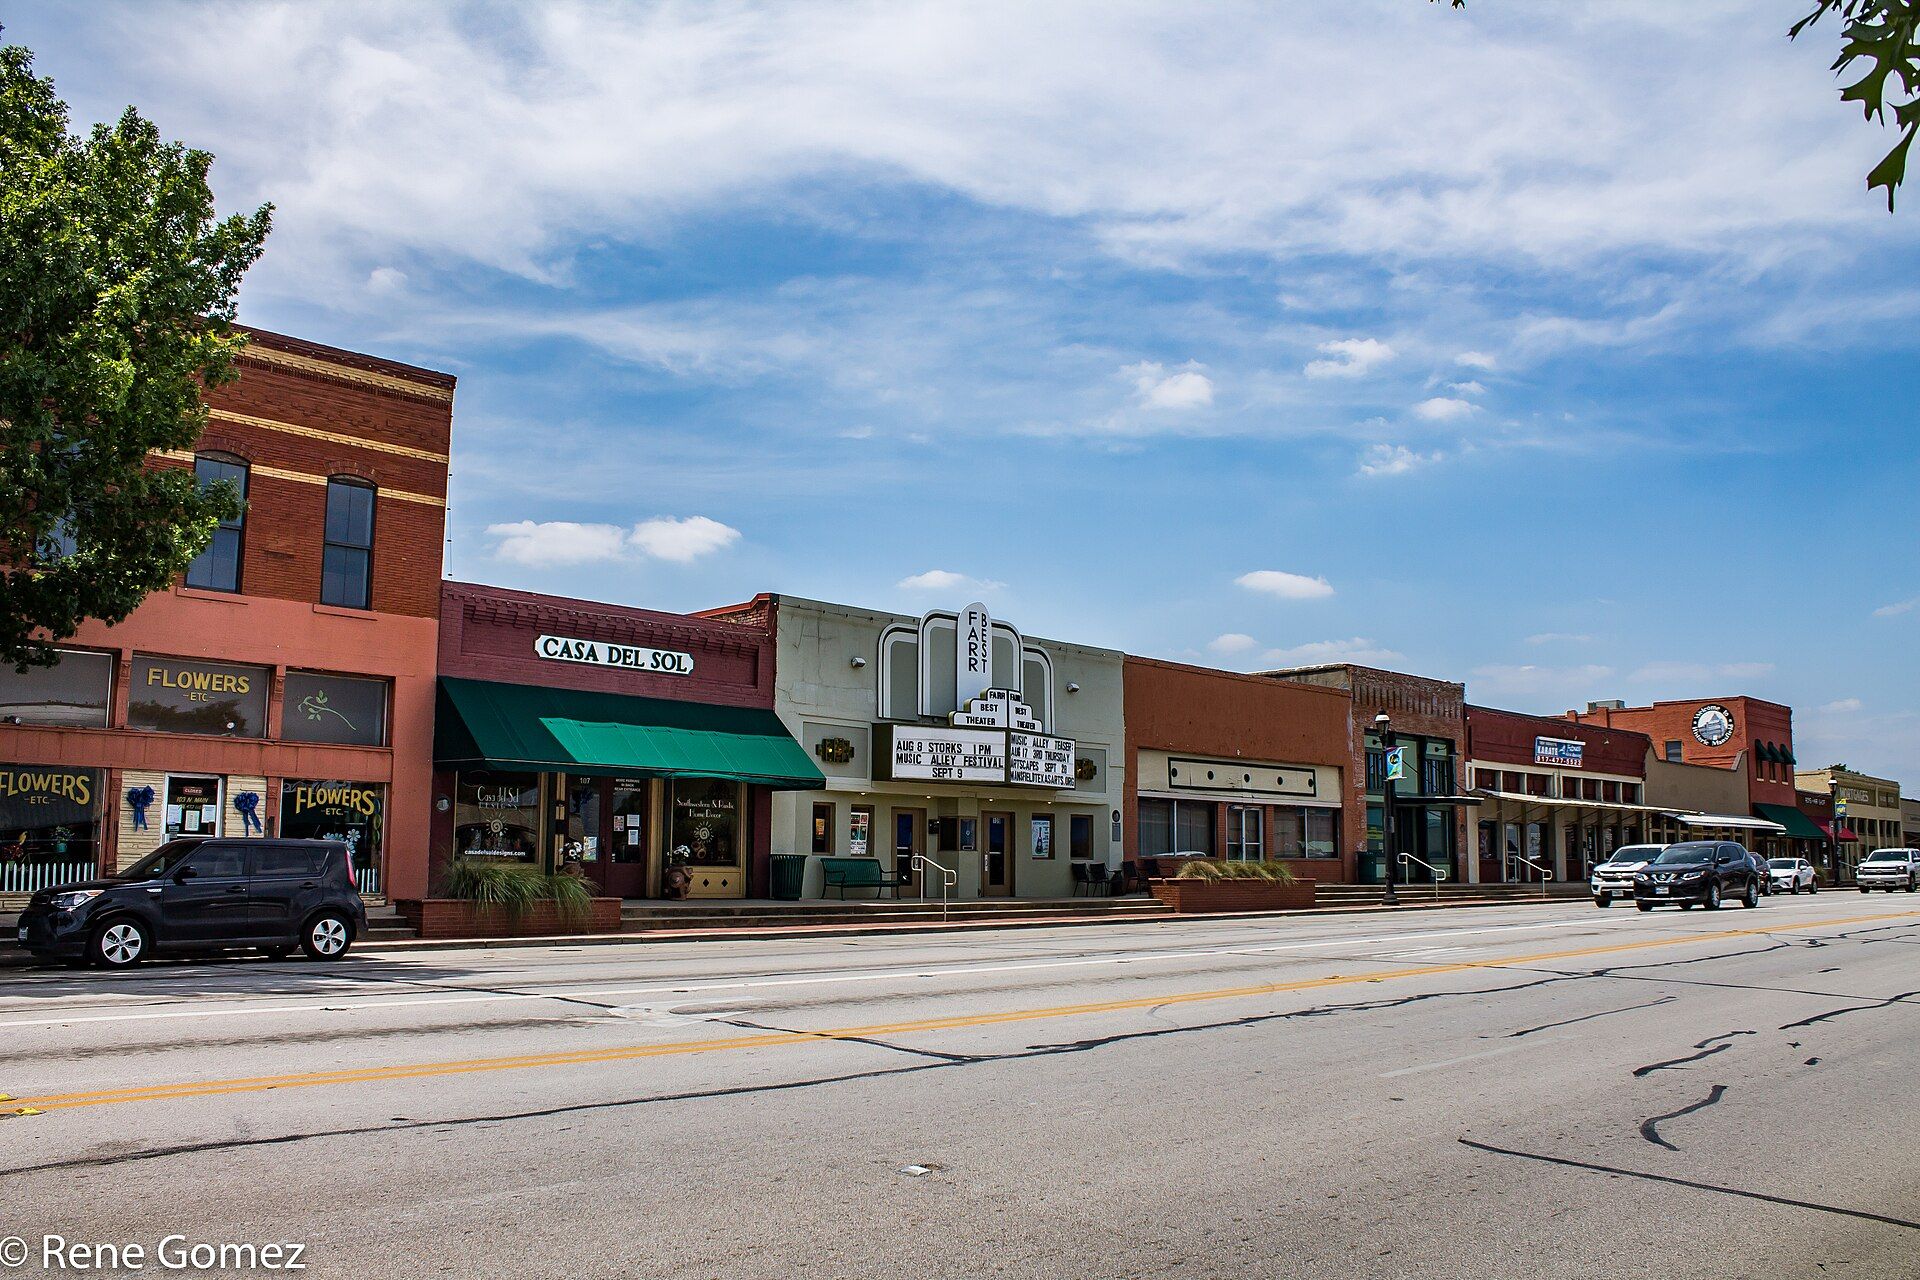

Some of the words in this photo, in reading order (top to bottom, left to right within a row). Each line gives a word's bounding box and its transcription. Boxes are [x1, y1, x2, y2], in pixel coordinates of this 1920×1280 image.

[968, 611, 979, 672] FARR
[543, 638, 599, 662] CASA
[607, 646, 645, 667] DEL
[651, 651, 687, 673] SOL
[147, 667, 250, 694] FLOWERS
[989, 691, 1006, 700] FARR
[980, 703, 998, 712] BEST
[1015, 706, 1027, 716] BEST
[1694, 705, 1721, 719] Welcome
[966, 715, 996, 726] THEATER
[1017, 720, 1036, 730] THEATER
[896, 740, 915, 752] AUG
[917, 741, 923, 752] 8
[928, 742, 963, 754] STORKS
[1011, 734, 1028, 746] MUSIC
[1033, 737, 1050, 749] ALLEY
[896, 753, 922, 765] MUSIC
[930, 755, 957, 766] ALLEY
[963, 756, 1004, 768] FESTIVAL
[1011, 746, 1021, 757] AUG
[1022, 748, 1028, 758] 17
[1045, 751, 1071, 763] THURSDAY
[1011, 758, 1040, 771] ARTSCAPES
[1045, 762, 1057, 773] SEPT
[932, 768, 954, 778] SEPT
[957, 768, 963, 779] 9
[0, 771, 91, 806] FLOWERS
[477, 785, 496, 802] Casa
[295, 786, 377, 816] FLOWERS
[464, 849, 526, 857] casadelsoldesigns.com
